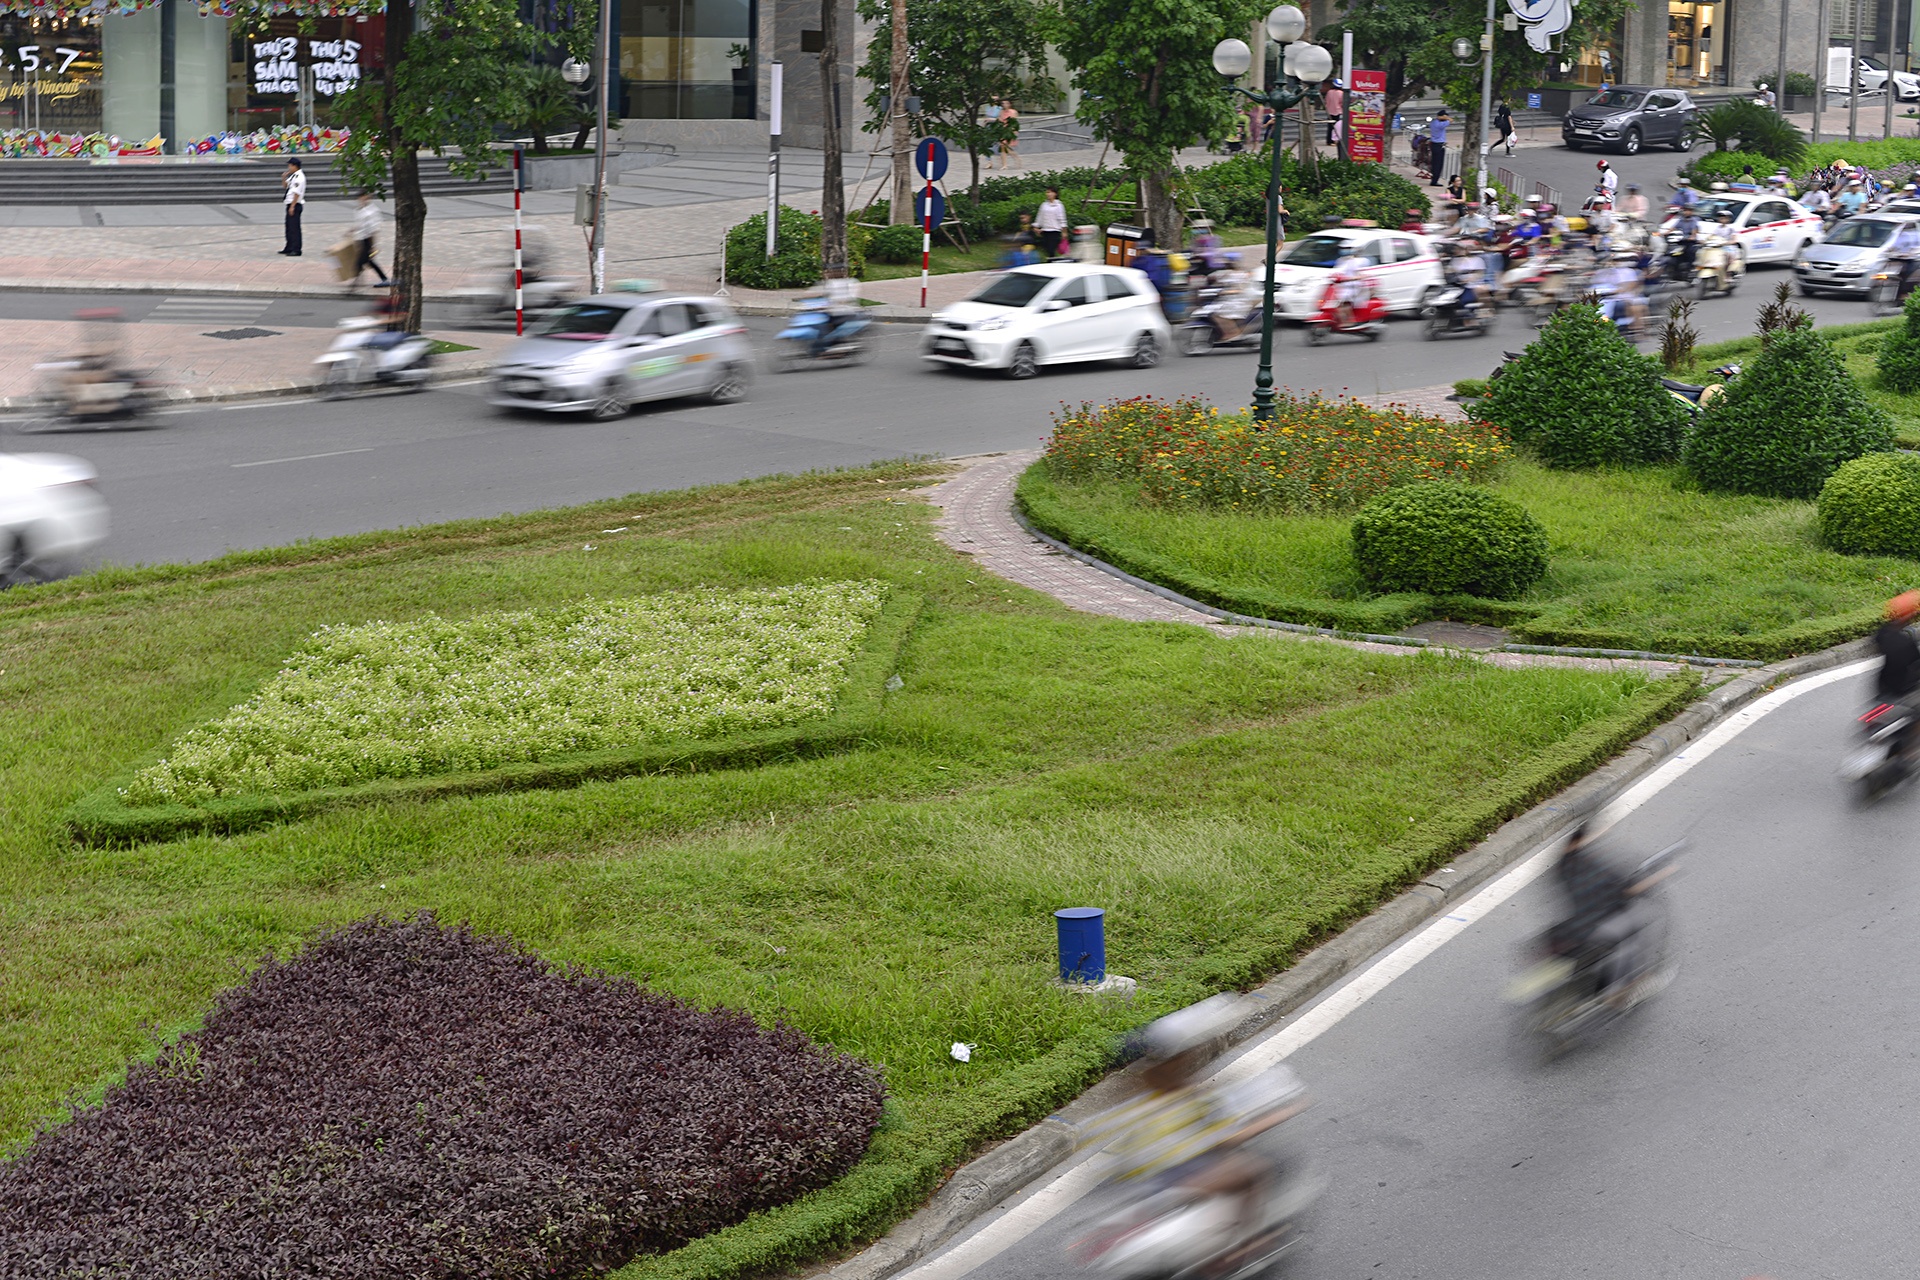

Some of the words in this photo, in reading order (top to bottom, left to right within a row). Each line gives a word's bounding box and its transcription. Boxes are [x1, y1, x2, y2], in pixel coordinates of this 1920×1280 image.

[279, 36, 300, 61] 3
[341, 39, 362, 62] 5
[33, 80, 80, 98] Vincom
[280, 80, 300, 94] GA
